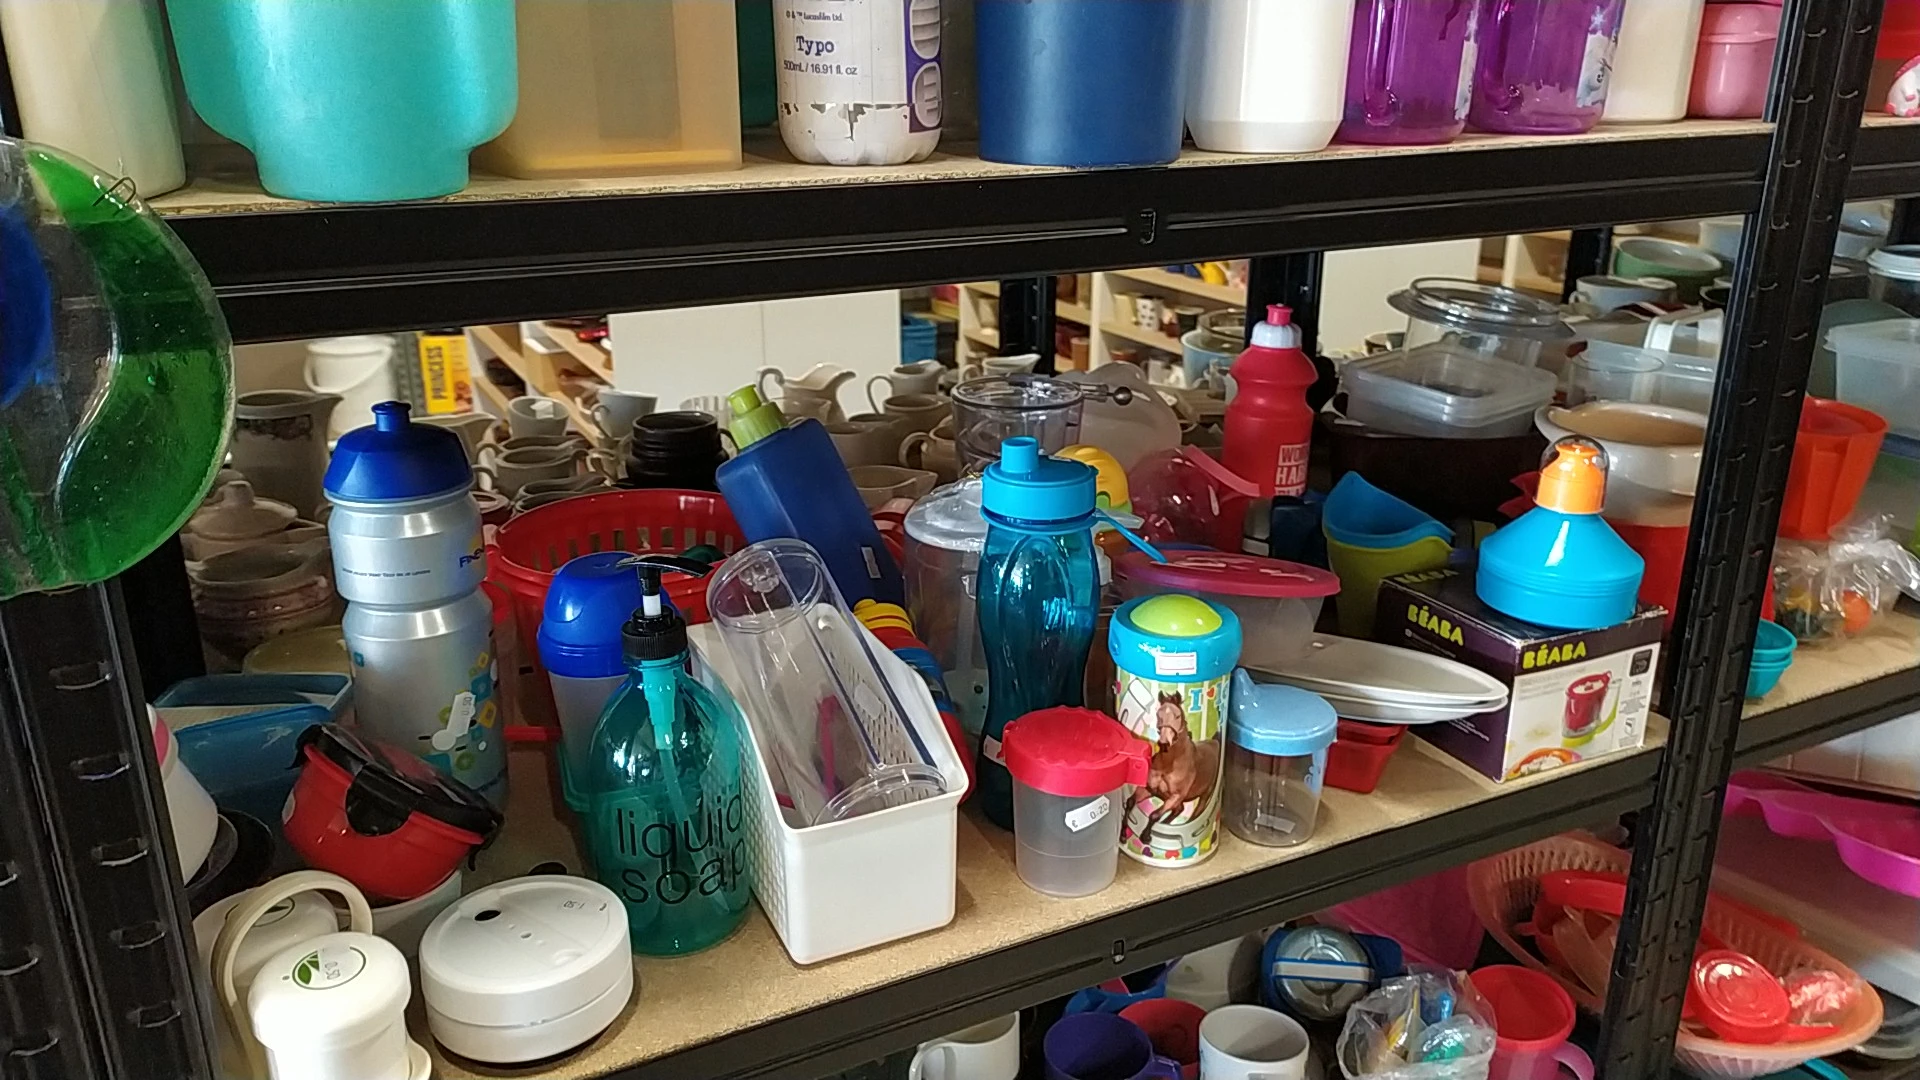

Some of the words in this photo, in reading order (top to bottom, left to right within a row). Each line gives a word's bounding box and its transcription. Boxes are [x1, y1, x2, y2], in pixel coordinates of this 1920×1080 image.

[795, 35, 835, 56] Typo
[783, 60, 805, 73] 500mL
[810, 63, 833, 75] 16.91
[845, 66, 858, 76] oz
[1407, 603, 1465, 647] BÉABA
[1522, 640, 1587, 669] BÉABA
[617, 780, 743, 869] liquid
[622, 838, 746, 904] soap
